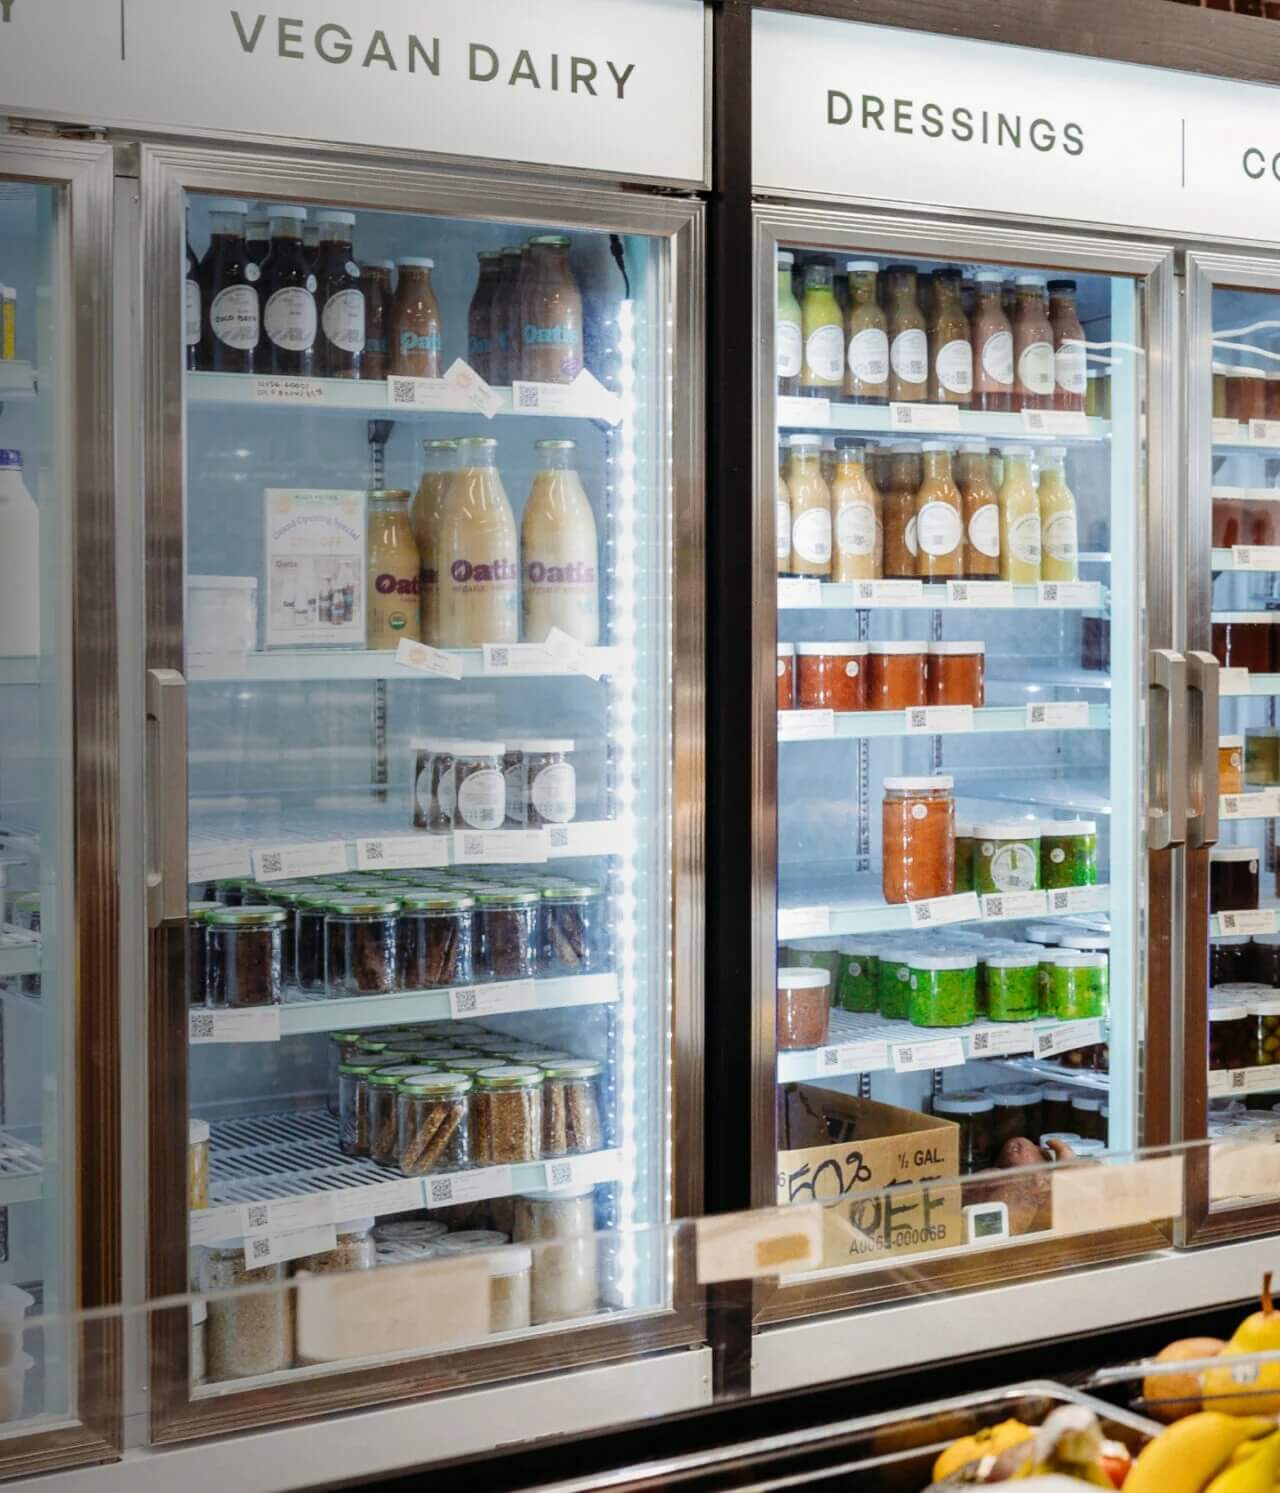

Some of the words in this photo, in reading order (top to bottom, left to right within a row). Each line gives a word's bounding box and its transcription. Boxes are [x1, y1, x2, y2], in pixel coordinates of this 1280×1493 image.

[230, 10, 441, 77] VEGAN
[468, 42, 637, 100] DAIRY
[826, 89, 1085, 156] DRESSINGS
[451, 559, 517, 583] Oatis
[528, 561, 595, 583] Oatis
[914, 1149, 945, 1166] GAL.
